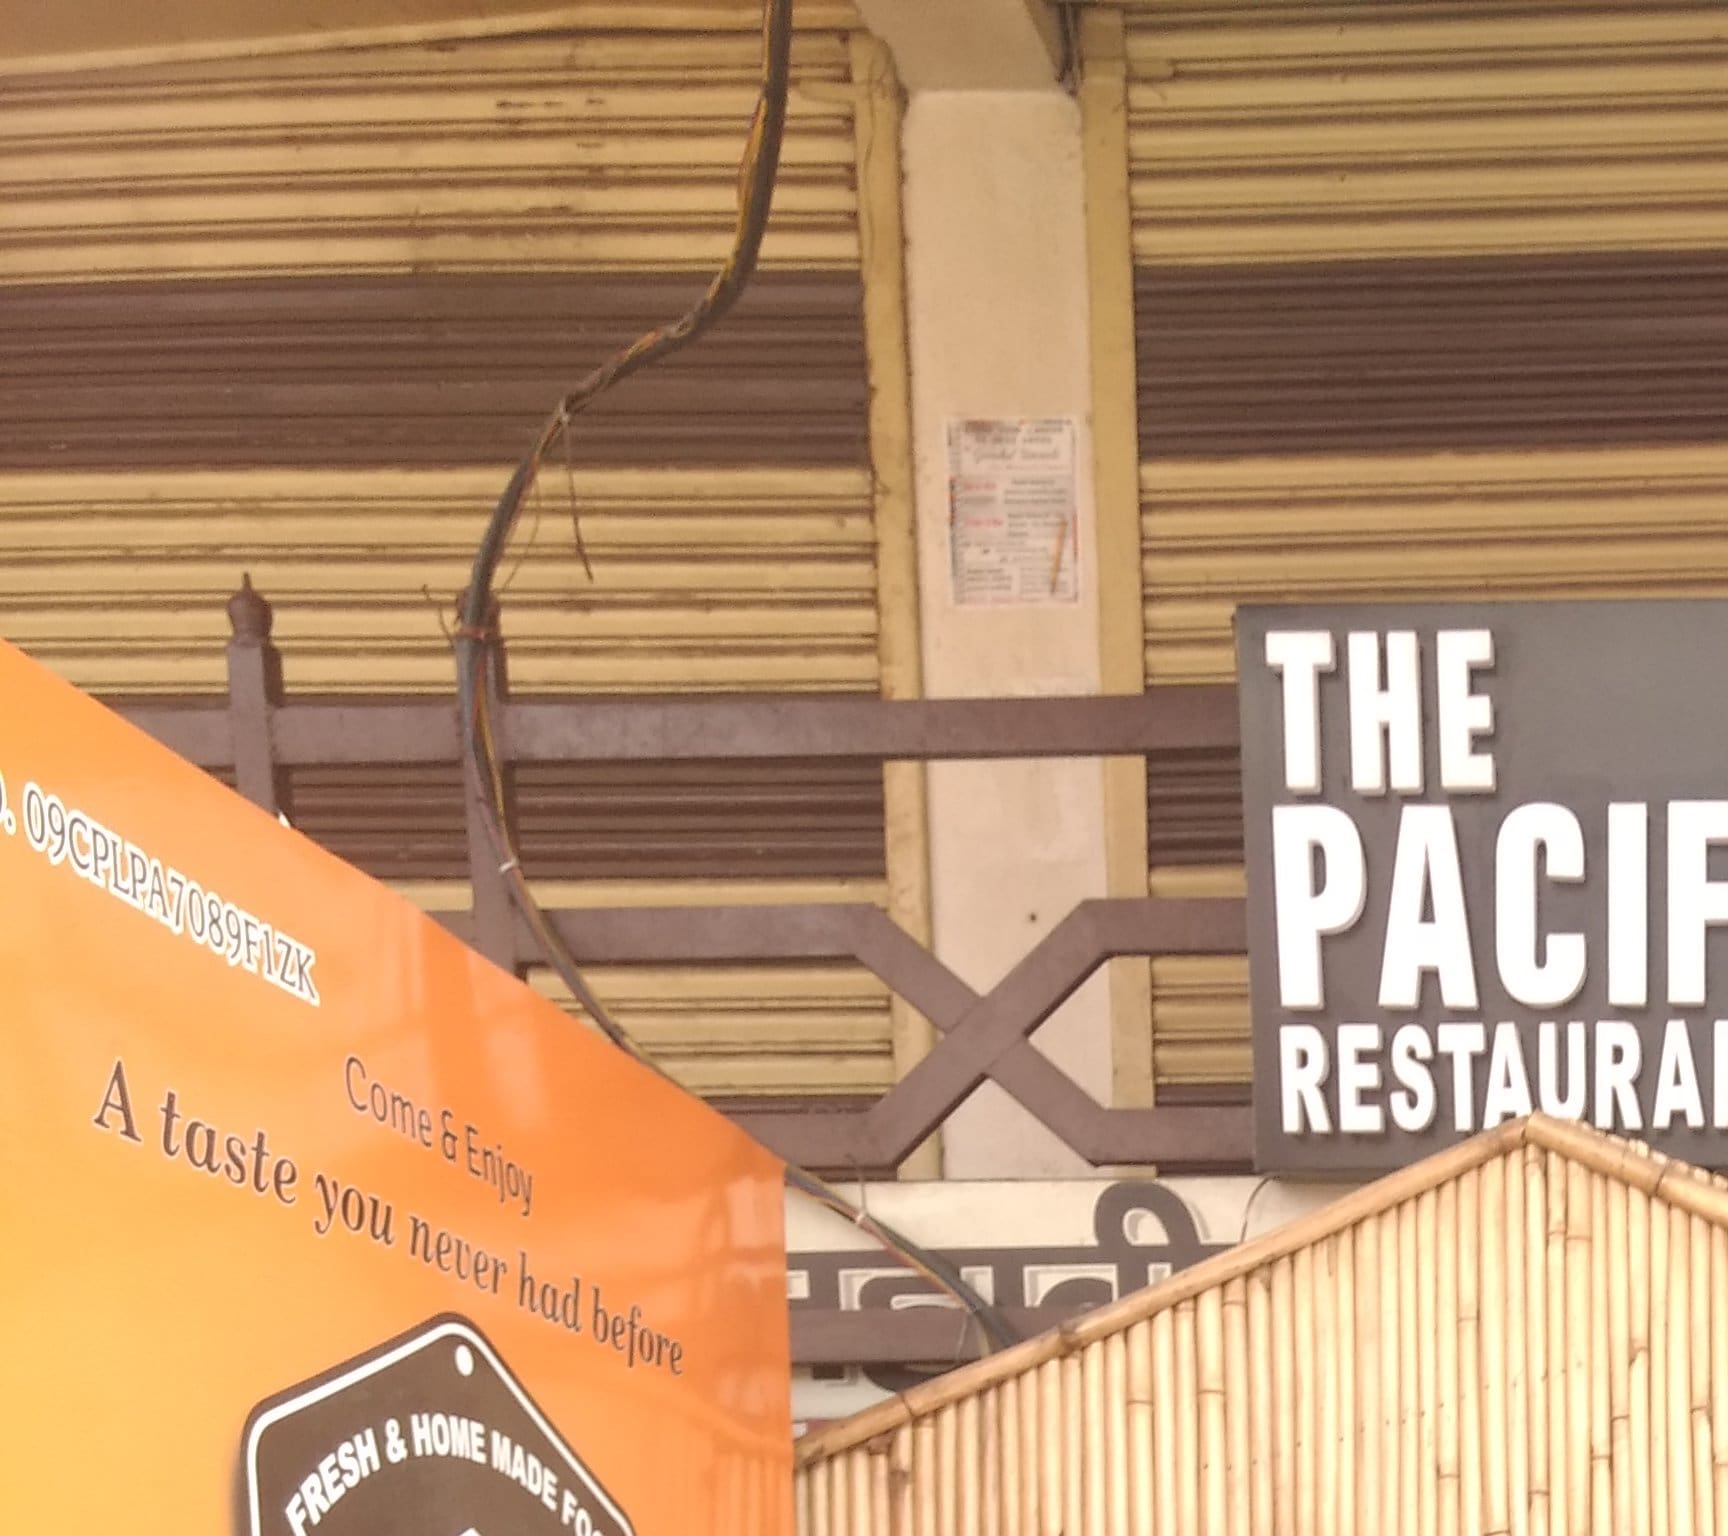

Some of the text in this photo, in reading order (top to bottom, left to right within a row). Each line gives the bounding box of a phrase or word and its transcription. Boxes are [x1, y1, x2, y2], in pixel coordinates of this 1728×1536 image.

[1265, 629, 1497, 795] THE
[93, 1059, 684, 1376] A taste you never had before
[345, 1056, 533, 1217] Come & Enjoy
[385, 1417, 409, 1465] &
[410, 1412, 487, 1466] HOME
[490, 1429, 558, 1513] MADE
